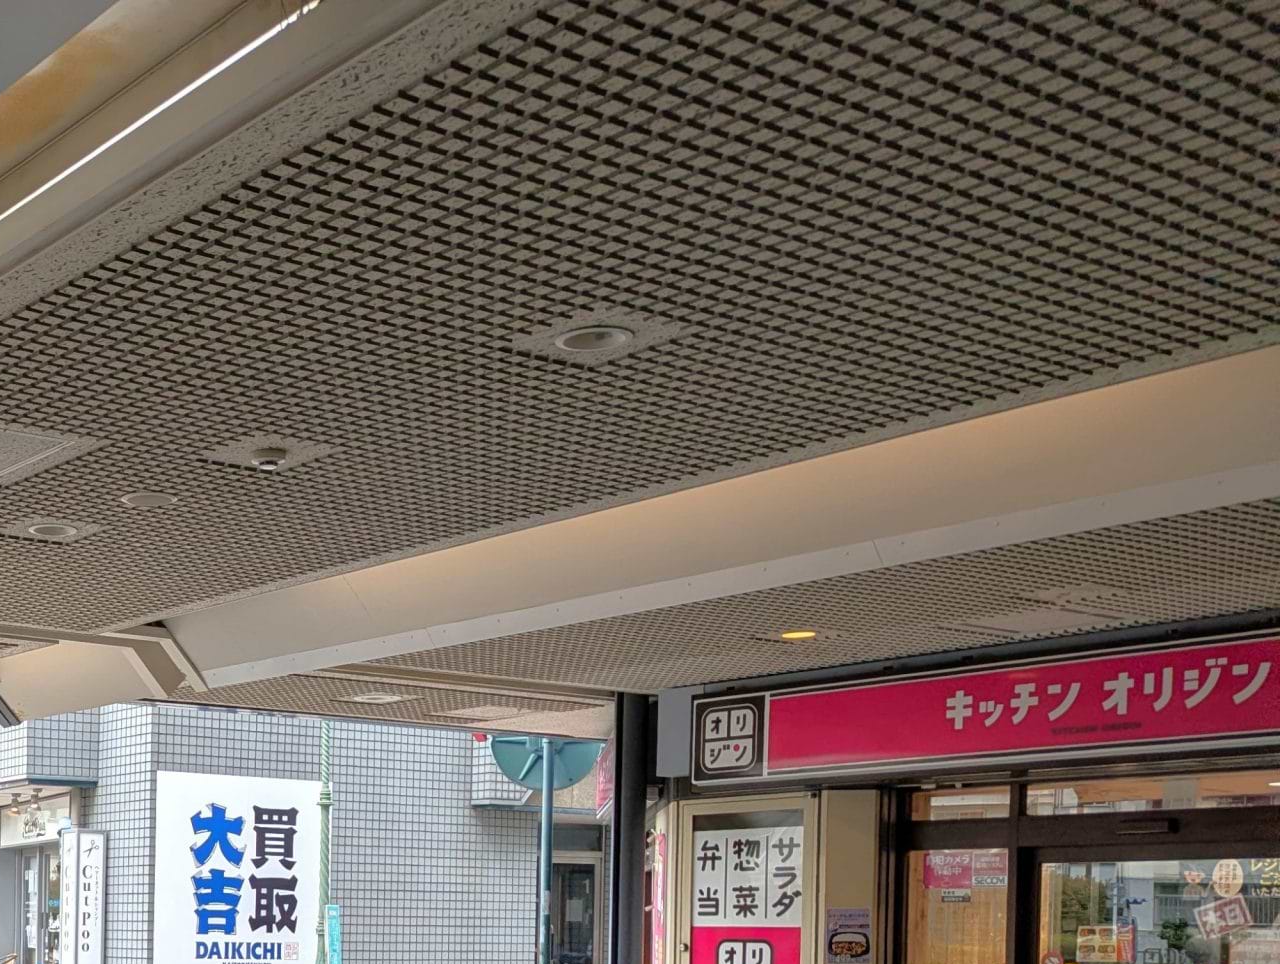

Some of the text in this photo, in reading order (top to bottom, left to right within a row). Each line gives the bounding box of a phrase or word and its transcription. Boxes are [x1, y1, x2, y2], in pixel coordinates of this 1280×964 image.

[944, 657, 1272, 731] キッチン オリジン
[189, 802, 248, 936] 大吉
[247, 804, 300, 935] 買取
[697, 840, 722, 917] 弁当
[732, 839, 761, 918] 惣菜
[771, 837, 802, 918] サラダ
[974, 876, 1006, 885] SECOM
[1251, 858, 1280, 872] レジ
[194, 941, 283, 961] DAIKICHI
